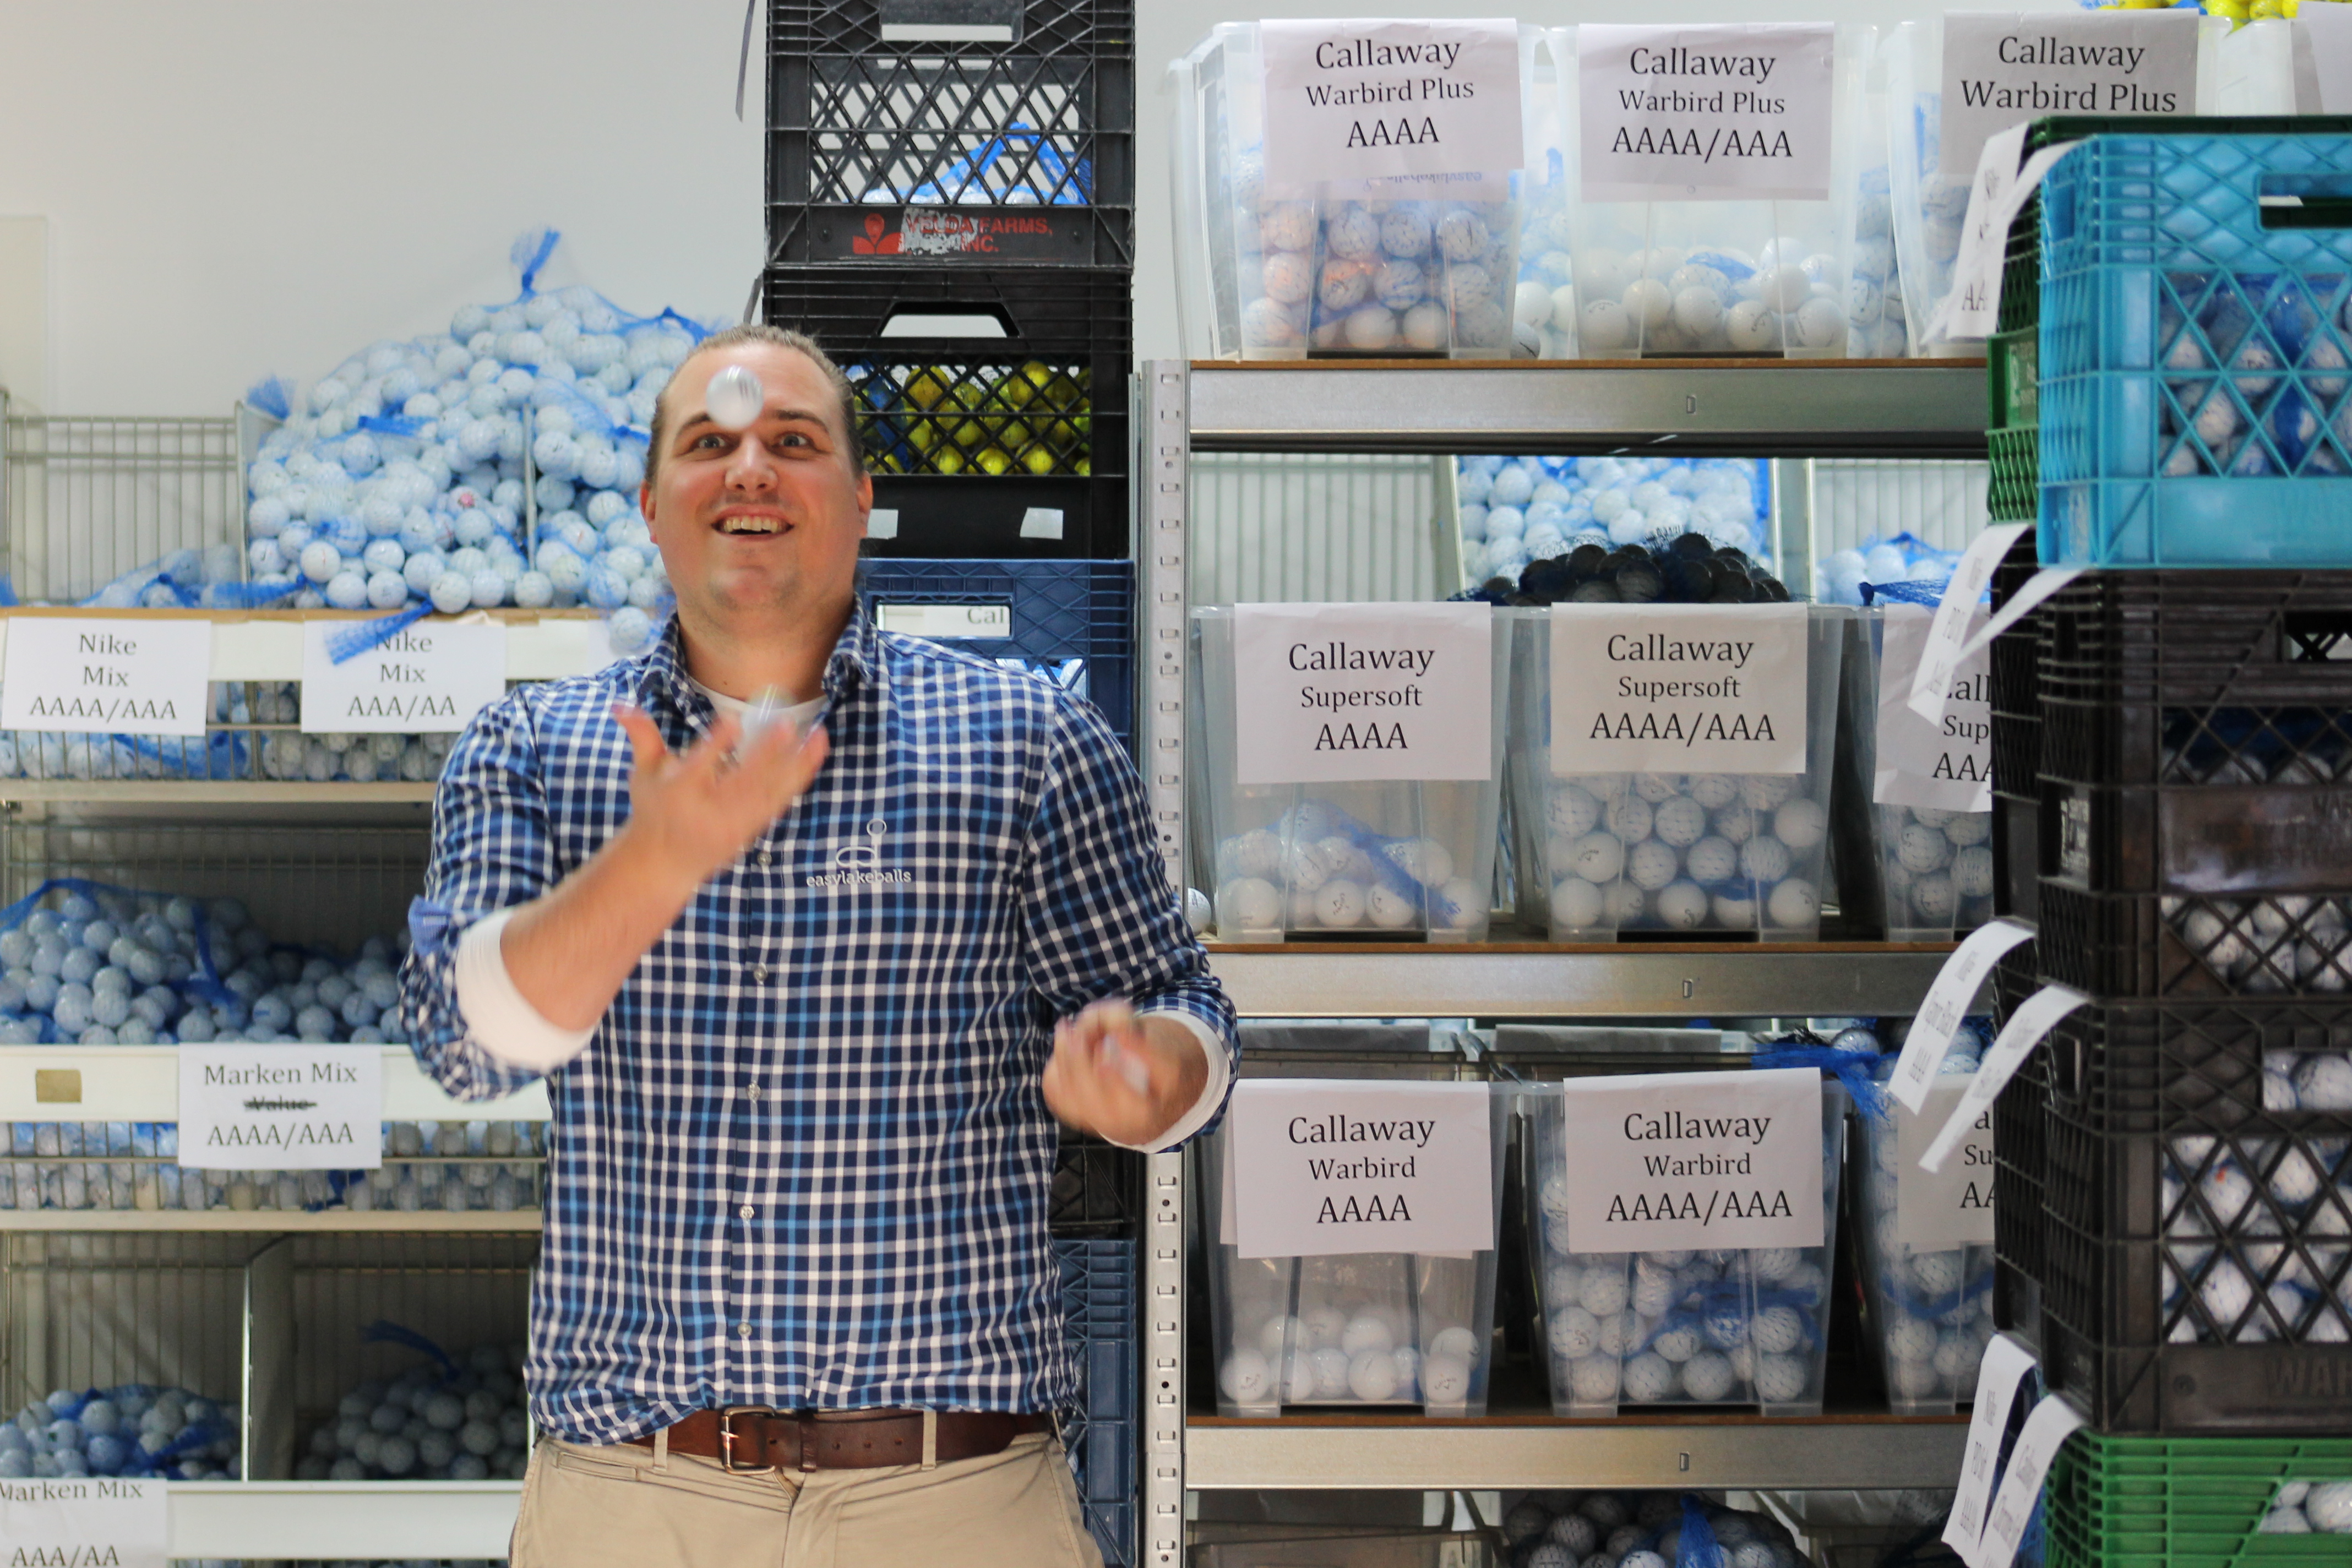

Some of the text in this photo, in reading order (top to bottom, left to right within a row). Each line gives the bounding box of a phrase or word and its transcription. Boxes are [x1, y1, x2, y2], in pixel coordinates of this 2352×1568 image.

[1316, 39, 1461, 70] Callaway
[1630, 47, 1776, 84] Callaway
[1998, 36, 2146, 74] Callaway
[1305, 77, 1474, 107] Warbird Plus
[1619, 90, 1785, 114] Warbird Plus
[1961, 80, 2176, 113] Warbird Plus
[1346, 117, 1440, 148] AAAA
[1611, 127, 1793, 164] AAAA/AAA
[906, 215, 1053, 236] VELDA FARMS,
[967, 606, 1004, 623] Cal
[80, 634, 137, 655] Nike
[1608, 634, 1754, 669] Callaway
[381, 663, 425, 683] Mix
[1289, 641, 1435, 677] Callaway
[84, 665, 128, 687] Mix
[1619, 676, 1741, 703] Supersoft
[1947, 674, 1991, 702] all
[30, 696, 177, 723] AAAA/AAA
[347, 695, 455, 722] AAA/AA
[1301, 684, 1422, 713] Supersoft
[1314, 722, 1408, 750] AAAA
[1589, 712, 1776, 748] AAAA/AAA
[806, 868, 912, 887] easylakeballs
[205, 1063, 357, 1086] Marken Mix
[208, 1123, 354, 1151] AAAA/AAA
[1289, 1114, 1436, 1148] Callaway
[1624, 1111, 1772, 1145] Callaway
[1308, 1156, 1417, 1180] Warbird
[1643, 1152, 1751, 1177] Warbird
[1316, 1194, 1412, 1223] AAAA
[1605, 1190, 1793, 1226] AAAA/AAA
[0, 1479, 143, 1501] Marken Mix
[11, 1544, 121, 1568] AAA/AA
